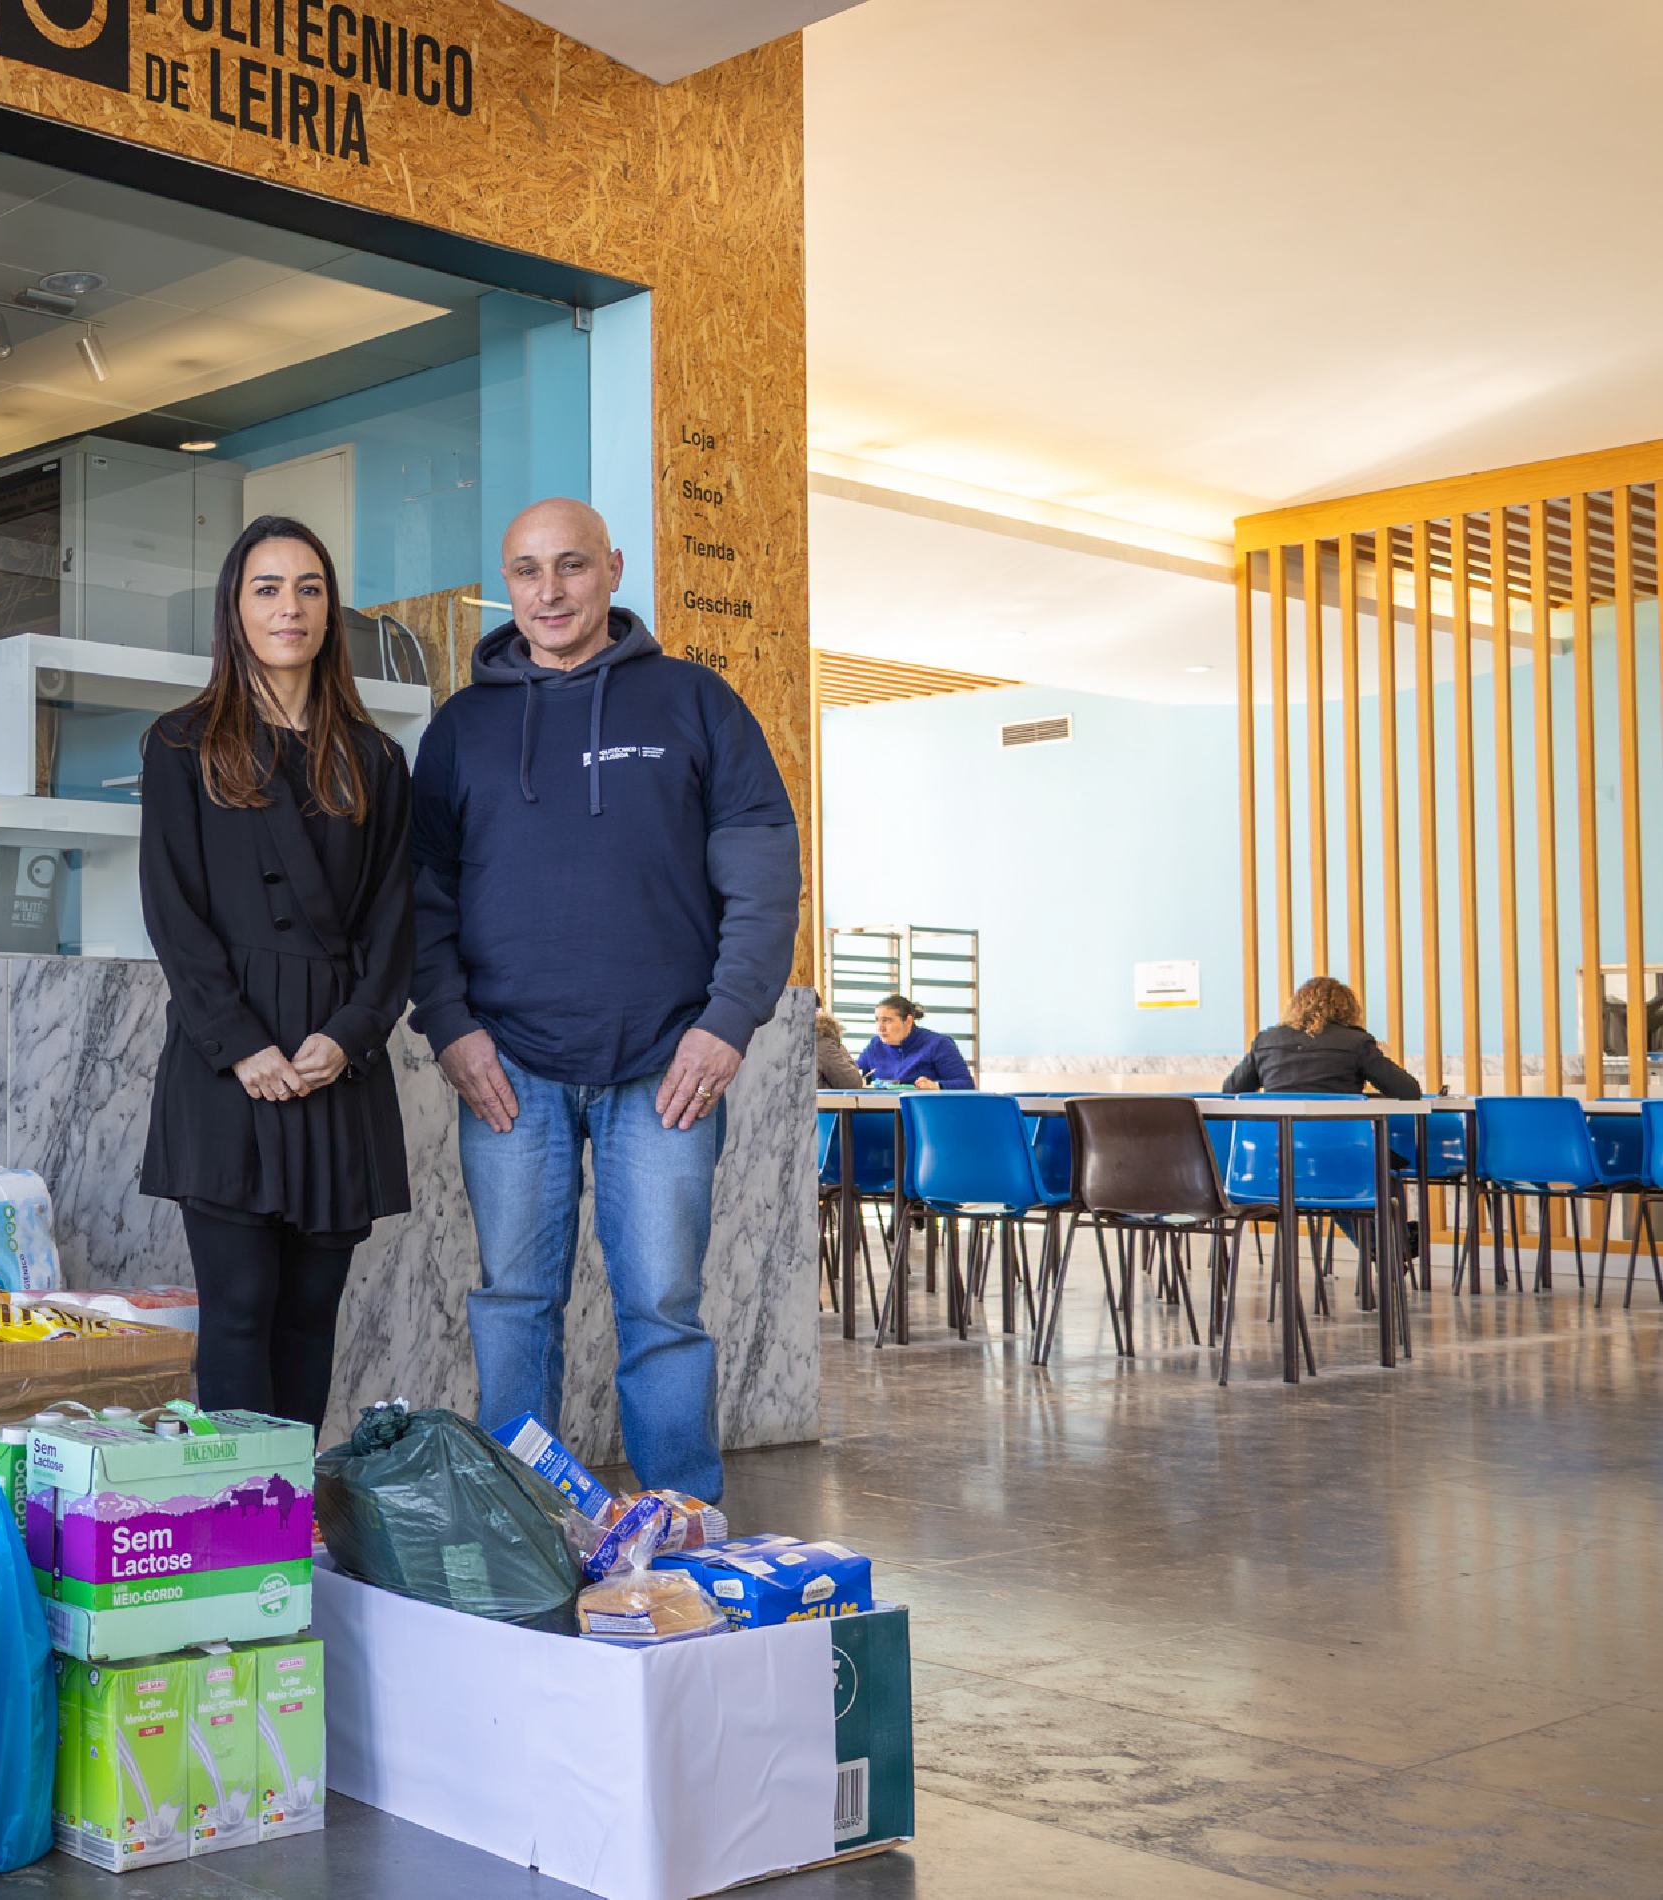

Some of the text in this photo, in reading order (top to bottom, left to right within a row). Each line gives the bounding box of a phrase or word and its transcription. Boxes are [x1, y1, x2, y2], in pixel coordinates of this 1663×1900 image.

[145, 46, 369, 166] DE LEIRIA
[681, 424, 716, 452] Loja
[682, 479, 724, 508] Shop
[682, 534, 736, 562] Tienda
[683, 590, 754, 620] Geschäft
[684, 644, 729, 673] Sklep
[34, 1438, 57, 1458] Sem
[184, 1440, 238, 1463] HACENDADO
[33, 1453, 64, 1473] Lactose
[112, 1526, 173, 1555] Sem
[111, 1550, 192, 1578] Lactose
[111, 1586, 183, 1607] MEIO-GORDO
[280, 1675, 301, 1687] Leite
[139, 1697, 163, 1710] Leite
[210, 1686, 232, 1699] Leite
[266, 1686, 316, 1702] Meio-Gordo
[123, 1708, 179, 1726] Meio-Gordo
[197, 1698, 248, 1714] Meio-Gordo
